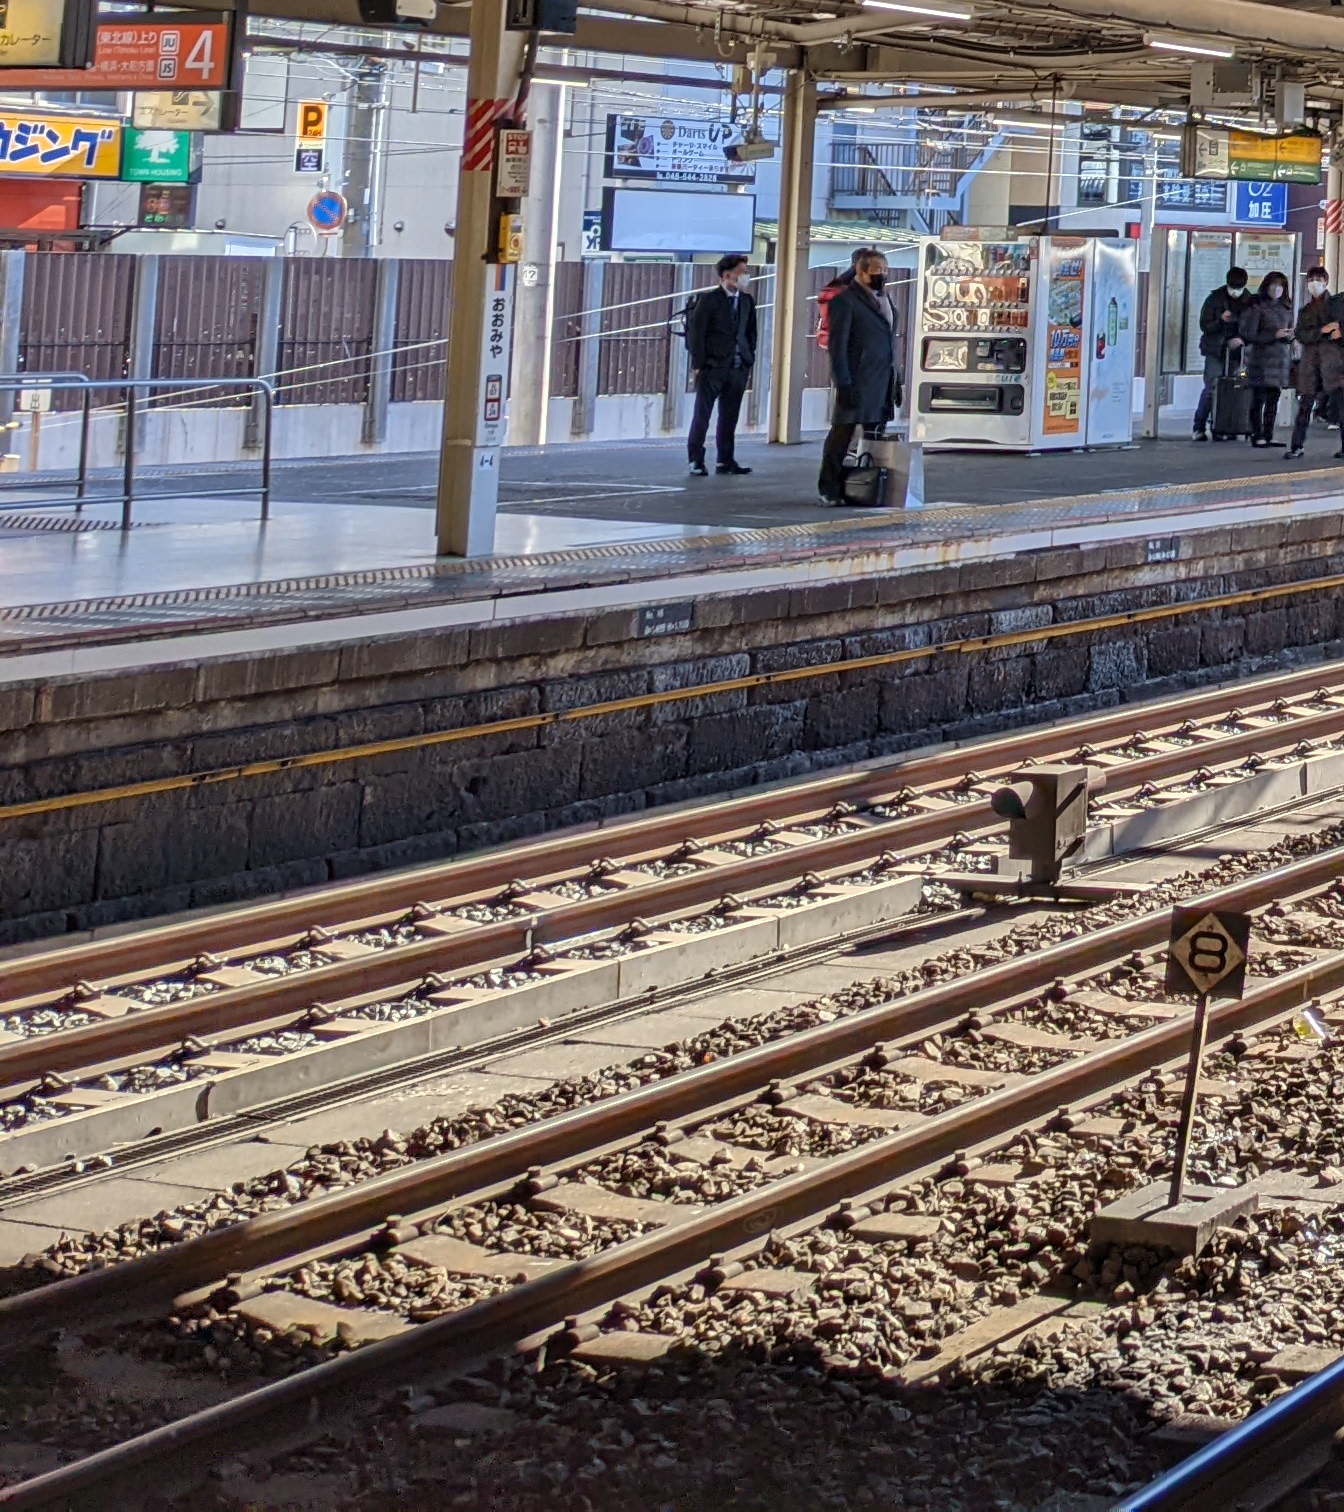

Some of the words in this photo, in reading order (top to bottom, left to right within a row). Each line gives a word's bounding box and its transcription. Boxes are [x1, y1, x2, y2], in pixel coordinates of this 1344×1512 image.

[164, 38, 175, 48] JU
[184, 30, 215, 80] 4
[162, 63, 172, 74] JS
[302, 106, 323, 136] P
[678, 125, 705, 139] Darts
[708, 124, 733, 144] UP
[301, 151, 319, 171] 空
[129, 168, 149, 176] TOWN
[151, 168, 182, 176] HOUSING
[1248, 200, 1273, 219] 加圧
[489, 297, 506, 359] おおみや
[1188, 930, 1228, 974] 8
